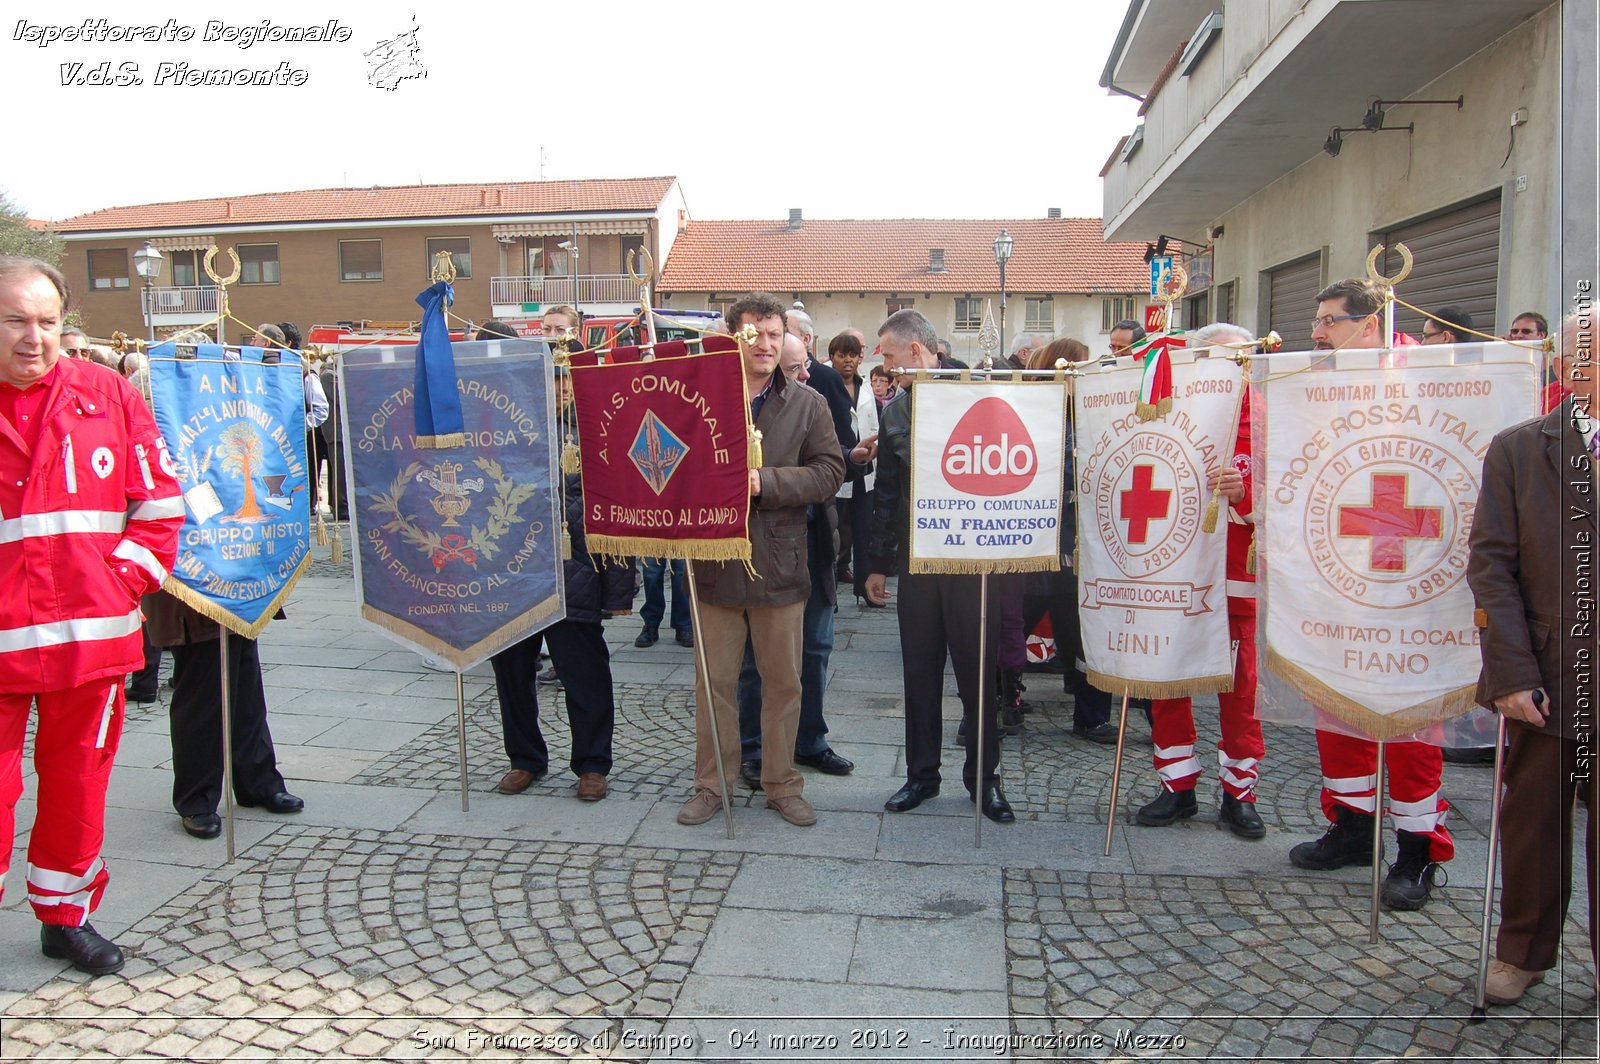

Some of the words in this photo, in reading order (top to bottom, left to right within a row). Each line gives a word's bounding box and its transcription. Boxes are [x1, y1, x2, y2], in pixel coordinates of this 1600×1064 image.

[1148, 310, 1164, 326] ill
[525, 328, 544, 336] FUOC
[1305, 385, 1376, 402] VOLONTARI
[1385, 383, 1408, 400] DEL
[1417, 380, 1491, 398] SOCCORSO
[456, 377, 540, 447] ARMONICA
[631, 375, 729, 464] COMUNALE
[271, 425, 304, 478] ANZIANI
[382, 436, 403, 451] LA
[408, 430, 517, 450] VRIOSA
[1131, 436, 1181, 463] GINEVRA
[945, 433, 1033, 476] aido
[1080, 430, 1112, 495] CROCE
[1172, 411, 1221, 477] ITALIAN
[1114, 451, 1129, 469] DI
[1274, 429, 1330, 505] CROCE
[1329, 403, 1422, 439] ROSSA
[1358, 440, 1449, 474] GINEVRA
[1176, 461, 1191, 482] 22
[1333, 456, 1353, 475] DI
[1446, 472, 1472, 496] 22
[592, 504, 605, 521] S.
[610, 505, 673, 527] FRANCESCO
[678, 508, 693, 526] AL
[698, 507, 738, 525] CAMPO
[916, 499, 976, 510] GRUPPO
[984, 499, 1058, 510] COMUNALE
[1172, 486, 1198, 544] AGOSTO
[186, 526, 254, 545] GRUPPO
[261, 522, 303, 539] MISTO
[917, 517, 951, 530] SAN
[961, 517, 1057, 530] FRANCESCO
[944, 534, 965, 546] AL
[976, 534, 1033, 546] CAMPO
[1309, 477, 1367, 597] CONVENZIONE
[221, 542, 262, 560] SEZIONE
[267, 541, 275, 555] DI
[368, 528, 388, 561] SAN
[388, 559, 481, 598] FRANCESCO
[487, 573, 508, 591] AL
[507, 521, 544, 575] CAMPO
[1143, 543, 1177, 570] 1864
[177, 550, 205, 579] SAN
[200, 570, 268, 599] FRANCESCO
[267, 573, 280, 591] AL
[278, 539, 306, 578] CAMPO
[1099, 586, 1136, 600] COMITATO
[1138, 589, 1188, 603] LOCALE
[1406, 568, 1453, 600] 1864
[408, 604, 455, 616] FONDATA
[460, 603, 481, 614] NEL
[486, 602, 510, 613] 1897
[1125, 610, 1136, 624] DI
[1301, 620, 1391, 642] COMITATO
[1400, 629, 1480, 647] LOCALE
[1343, 649, 1429, 675] FIANO
